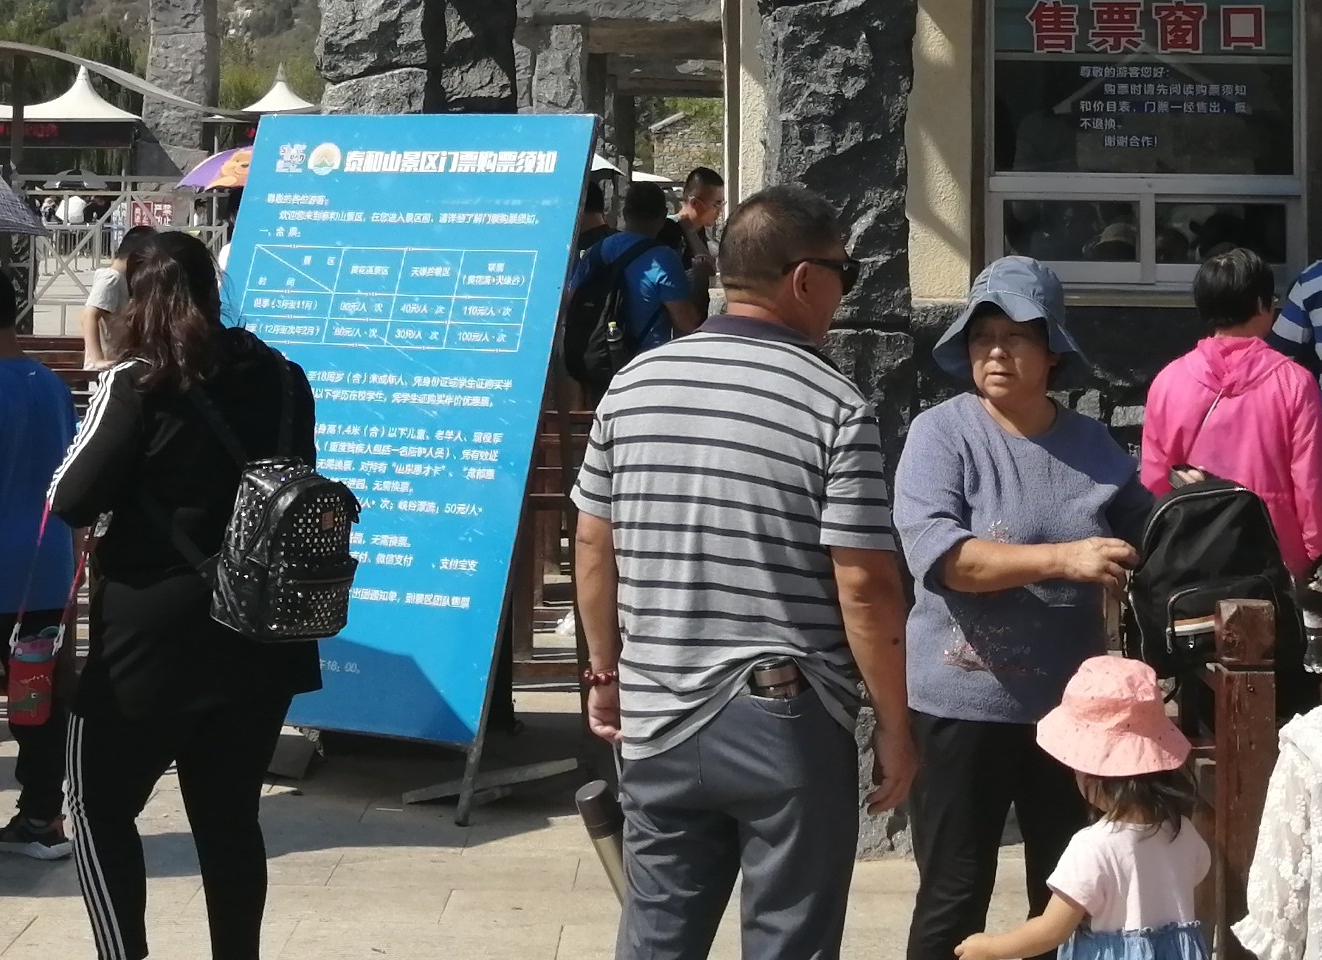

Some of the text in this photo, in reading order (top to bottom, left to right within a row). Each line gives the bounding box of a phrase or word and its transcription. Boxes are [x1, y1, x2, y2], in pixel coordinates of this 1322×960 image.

[1103, 84, 1247, 96] 购票时请先阅读购票须知
[1104, 135, 1158, 147] 谢谢合作！
[343, 149, 558, 174] 泰和山景区门票购票须知
